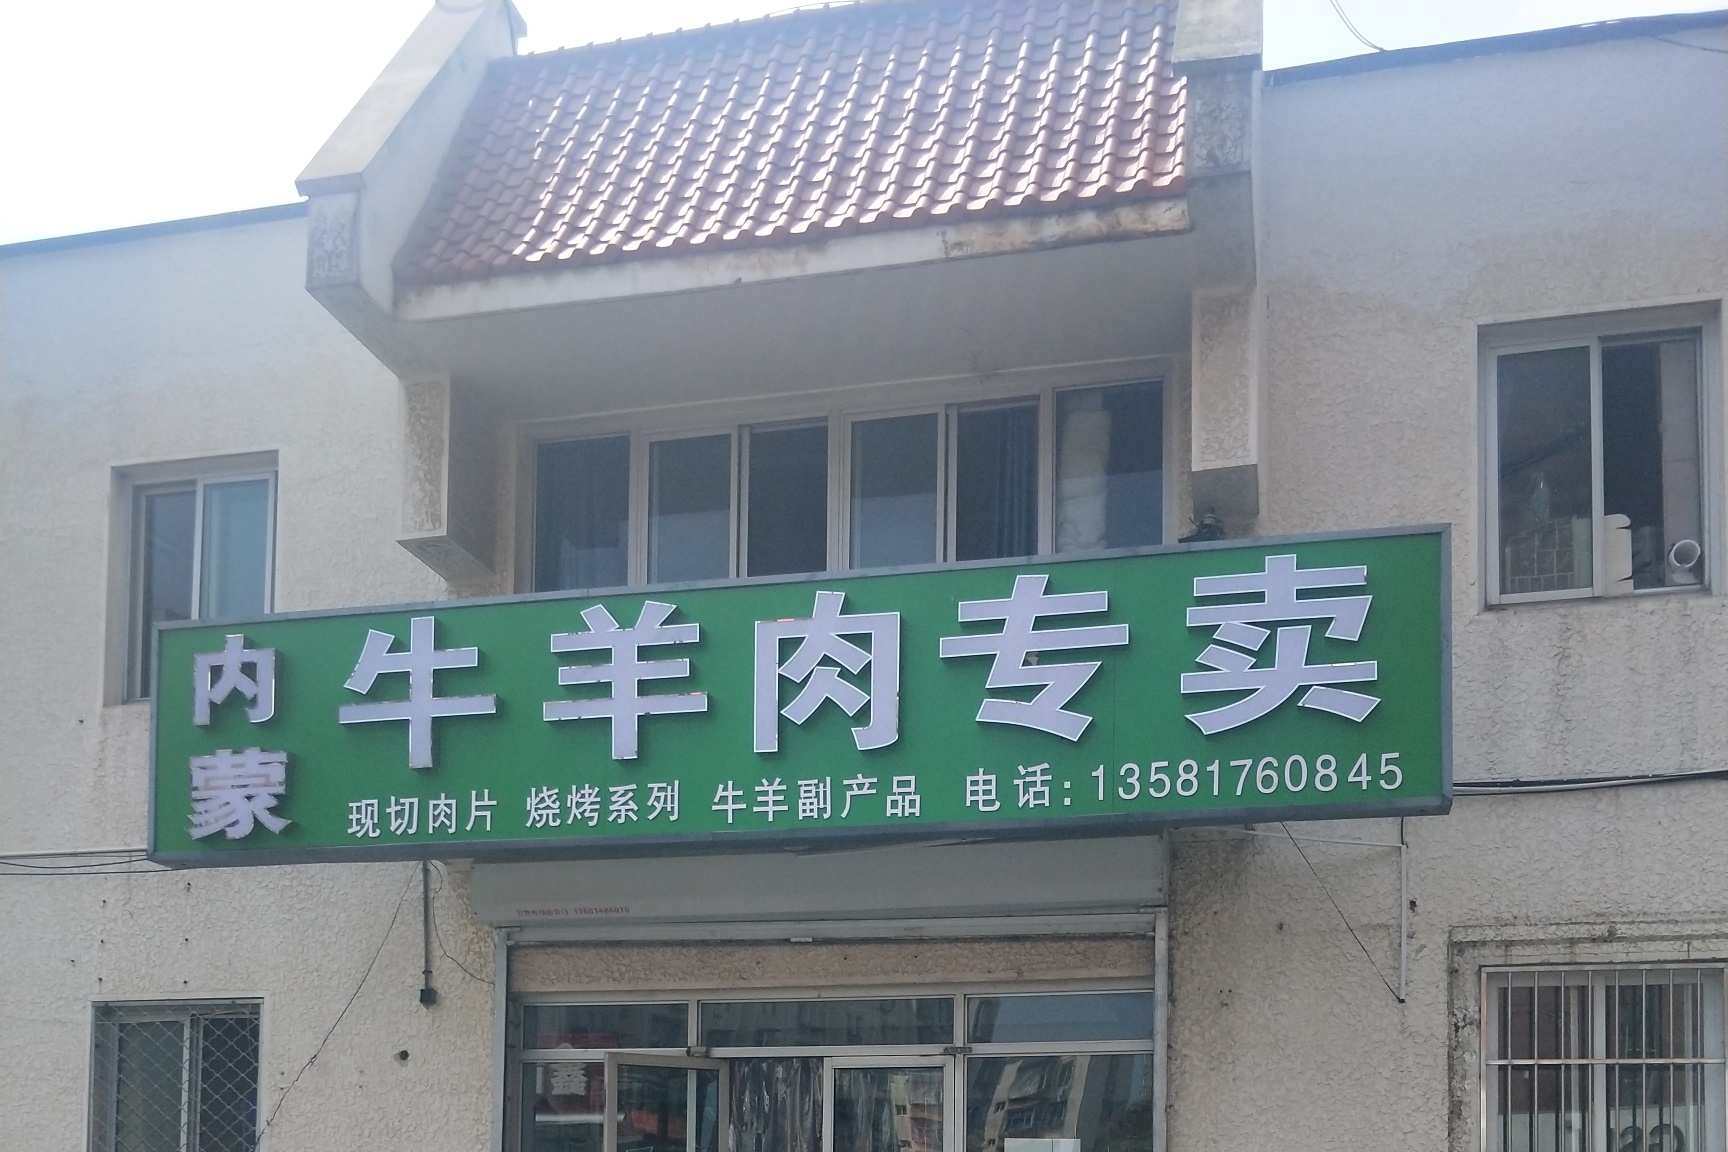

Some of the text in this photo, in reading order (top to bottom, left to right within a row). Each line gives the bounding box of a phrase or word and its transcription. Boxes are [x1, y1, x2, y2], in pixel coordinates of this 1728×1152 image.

[187, 633, 294, 842] 内蒙
[338, 552, 1382, 770] 牛羊肉专卖
[347, 788, 498, 838] 现切肉片
[525, 779, 680, 829] 烧烤系列
[711, 774, 922, 824] 牛羊副产品
